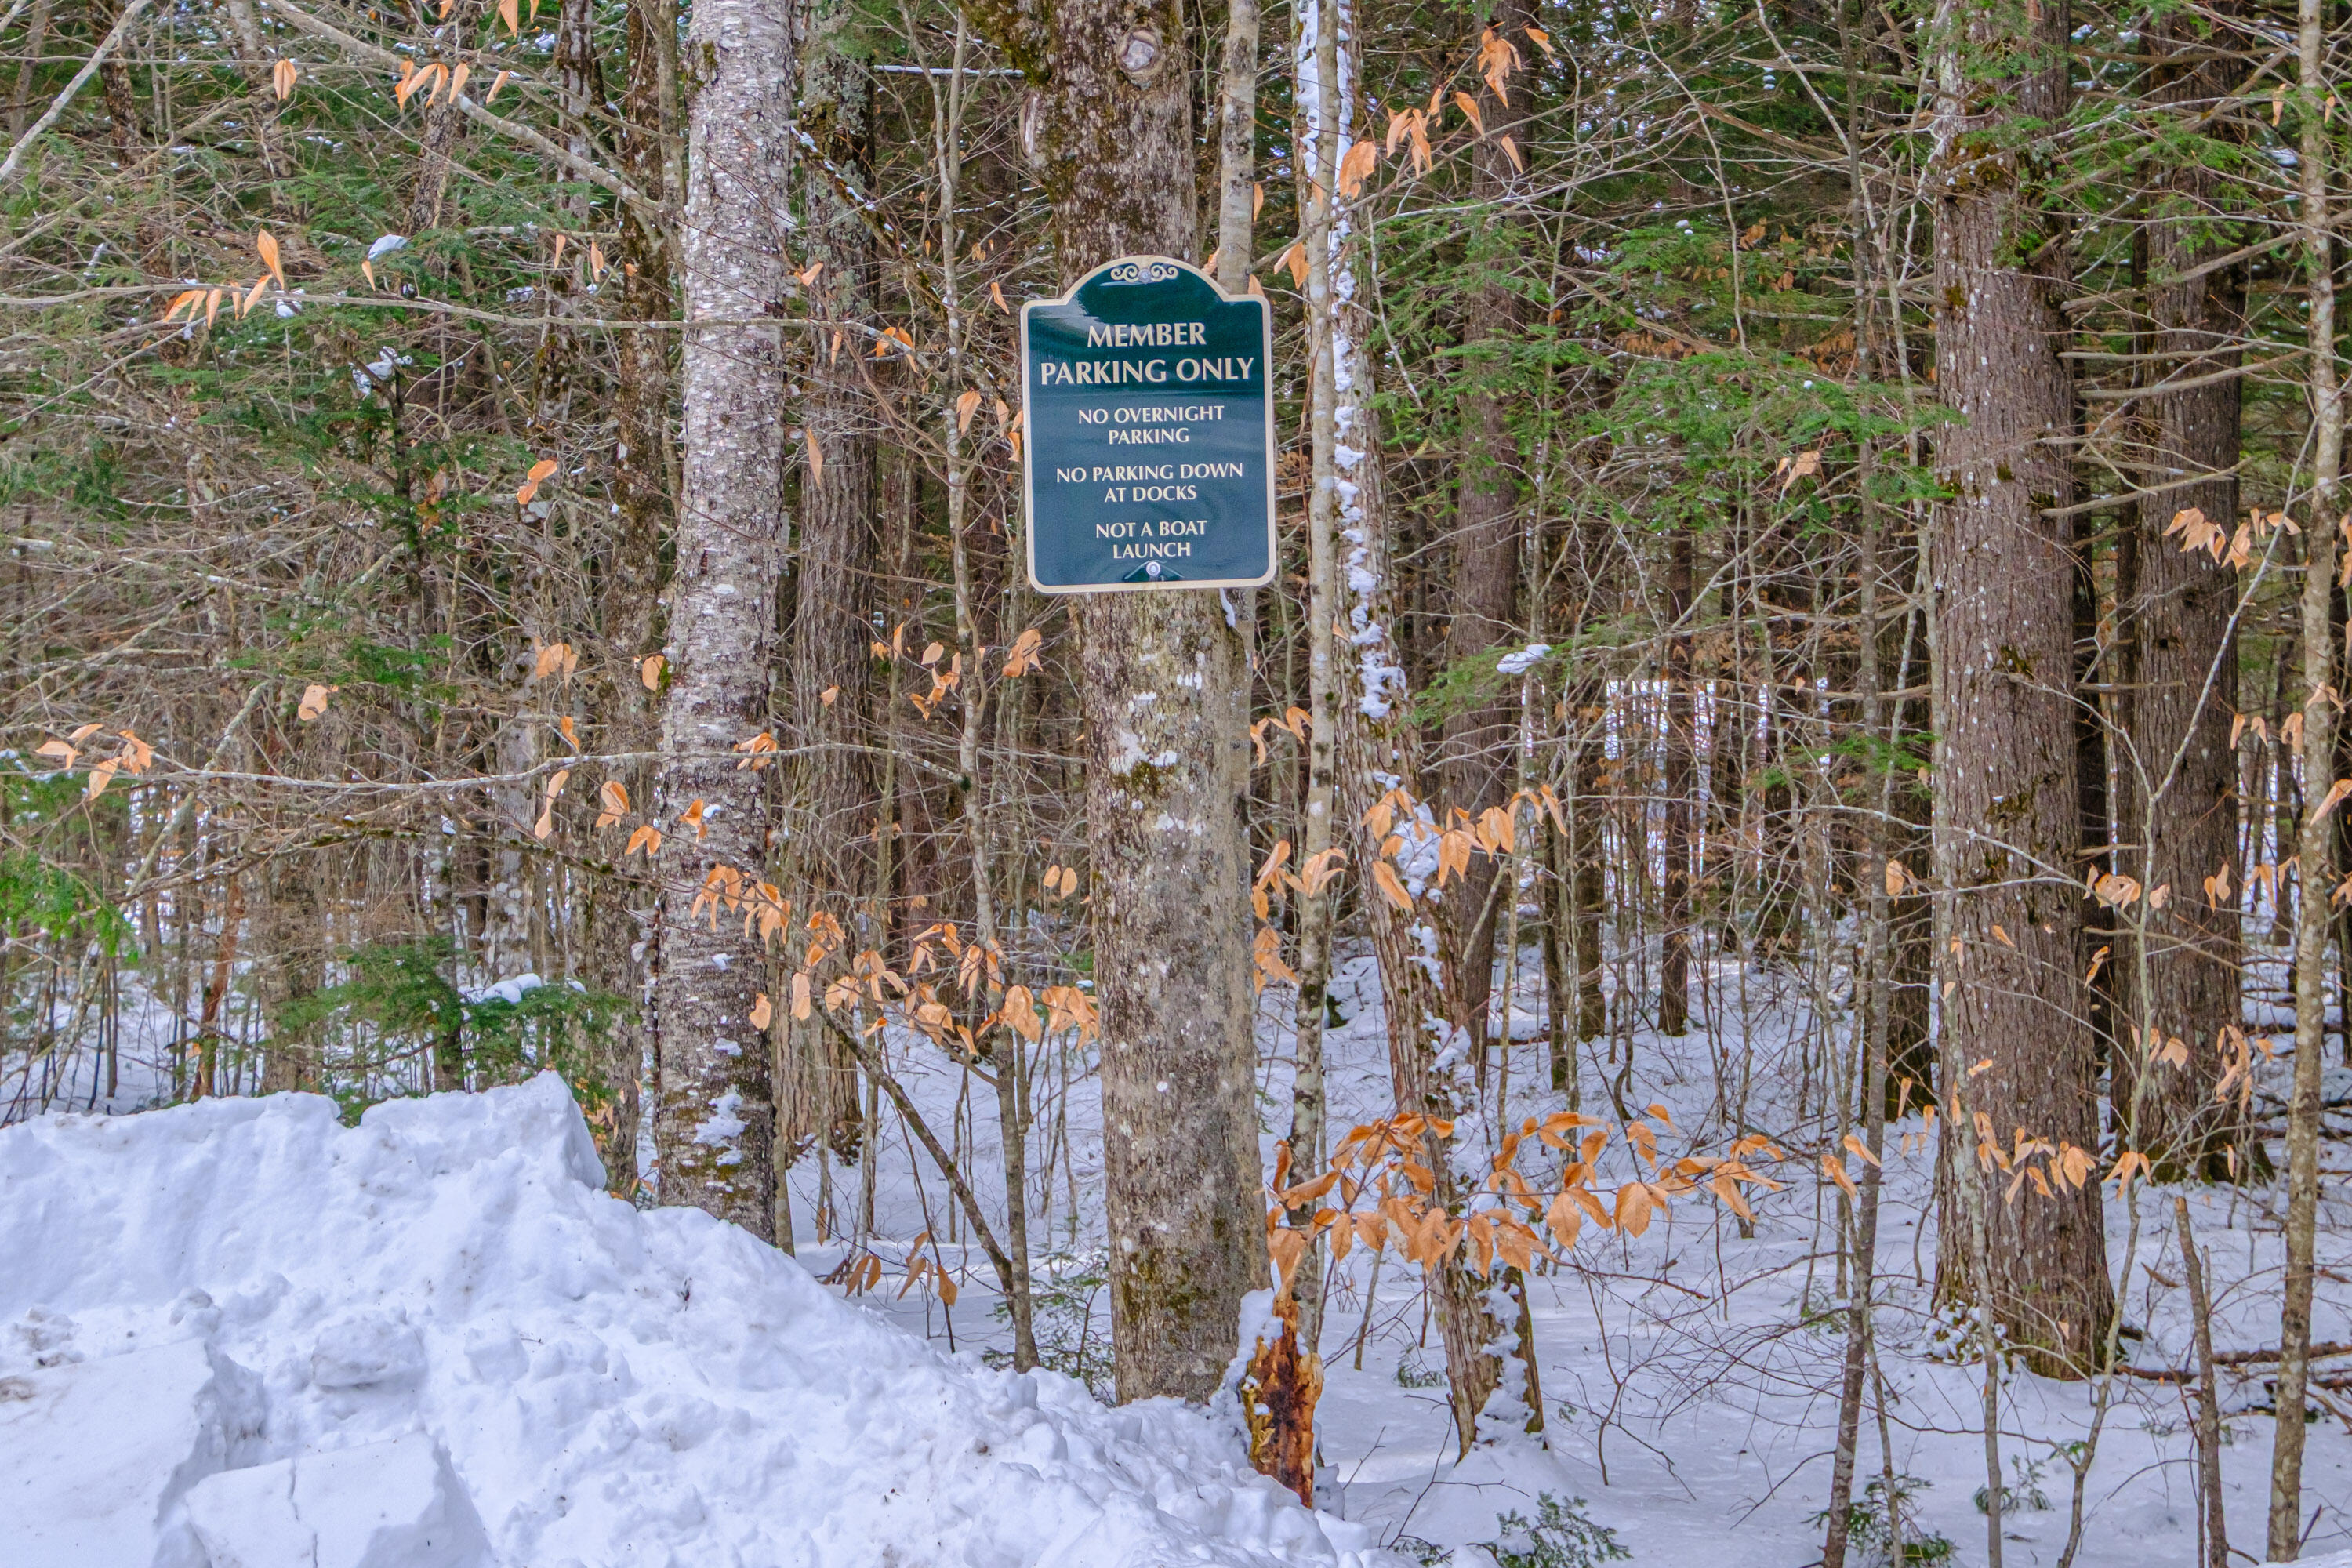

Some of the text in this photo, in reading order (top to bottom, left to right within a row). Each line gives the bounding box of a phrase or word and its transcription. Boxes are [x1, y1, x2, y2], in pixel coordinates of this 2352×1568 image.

[1087, 322, 1206, 347] MEMBER
[1040, 357, 1254, 386] PARKING ONLY
[1078, 405, 1225, 425] NO OVERNIGHT
[1109, 427, 1190, 445] PARKING
[1056, 462, 1243, 483] NO PARKING DOWN
[1104, 485, 1197, 503] AT DOCKS
[1096, 520, 1207, 539] NOT A BOAT
[1112, 542, 1191, 559] LAUNCH
